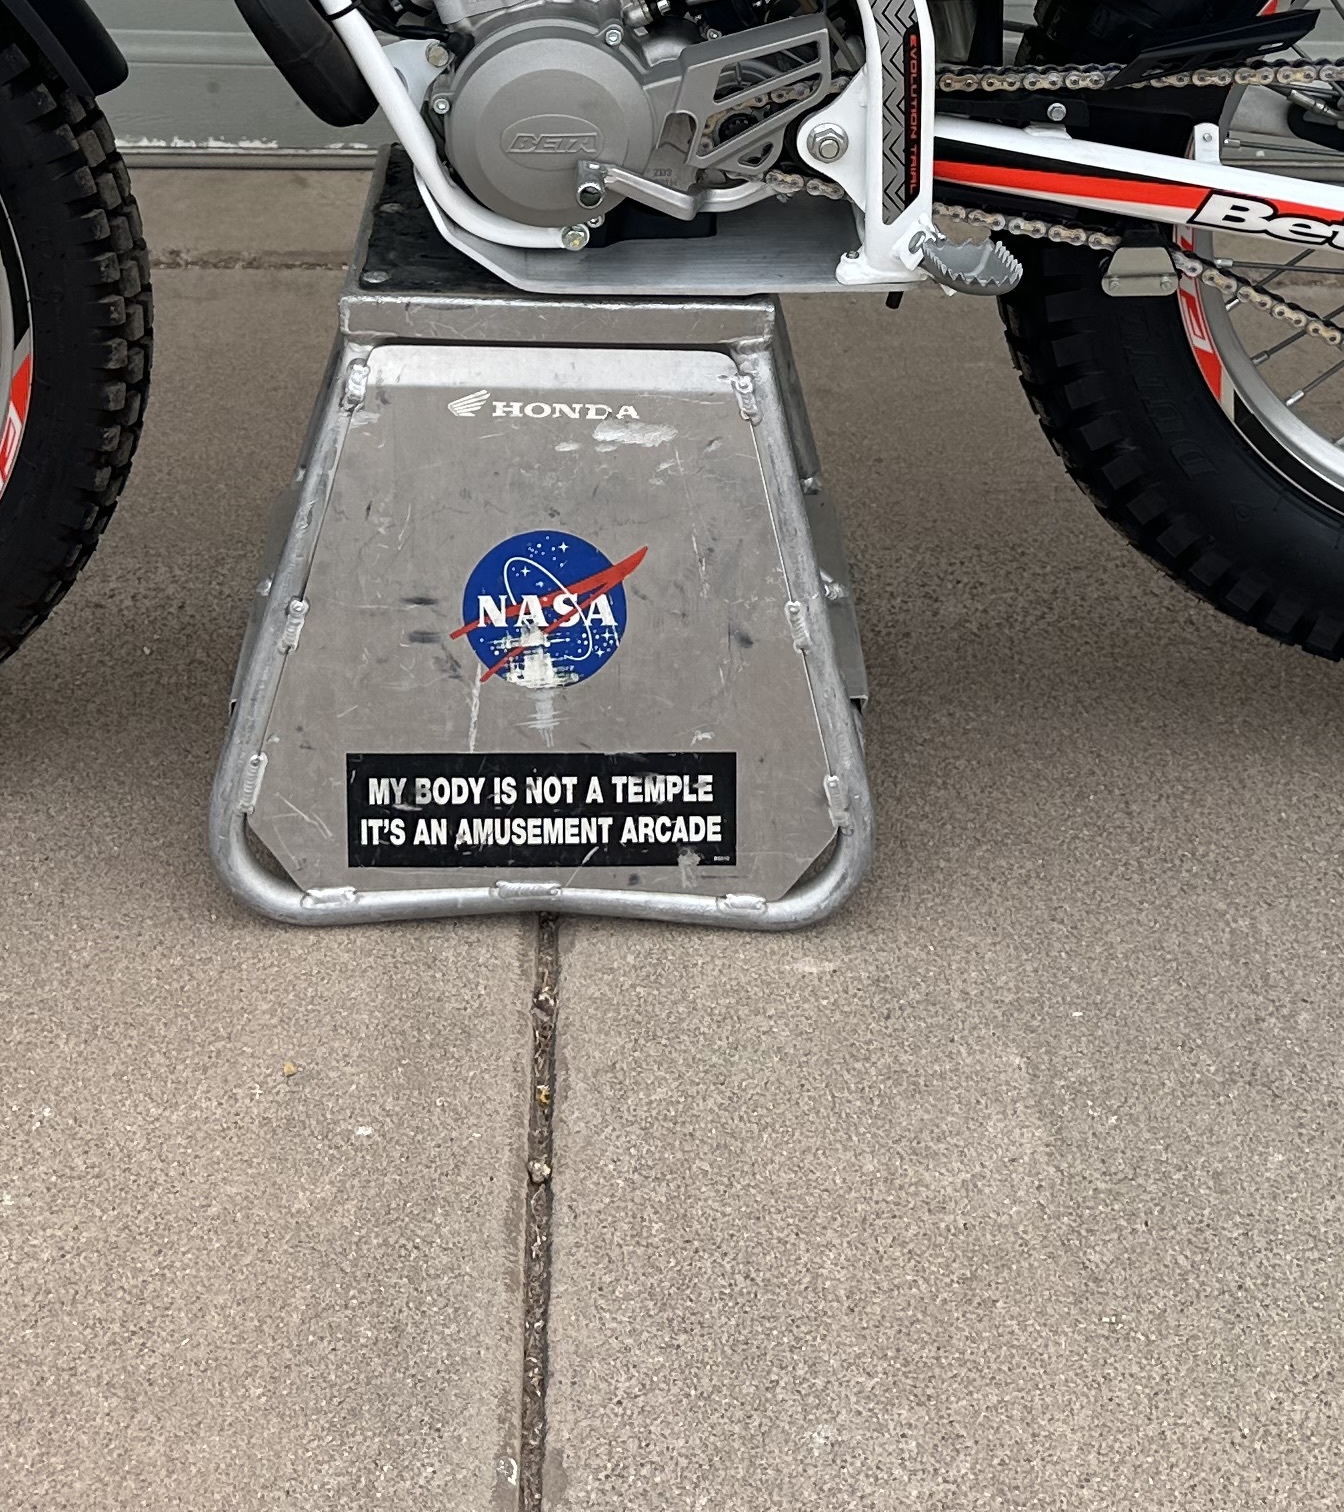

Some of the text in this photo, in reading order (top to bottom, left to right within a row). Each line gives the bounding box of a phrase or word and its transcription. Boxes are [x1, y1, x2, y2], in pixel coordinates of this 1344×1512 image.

[909, 33, 917, 195] EVOLUTION TRIAL
[506, 132, 598, 154] BETA
[492, 399, 640, 422] HONDA
[478, 593, 618, 629] NASA
[368, 774, 714, 805] MY BODY IS NOT A TEMPLE
[360, 815, 723, 845] IT'S AN AMUSEMENT ARCADE
